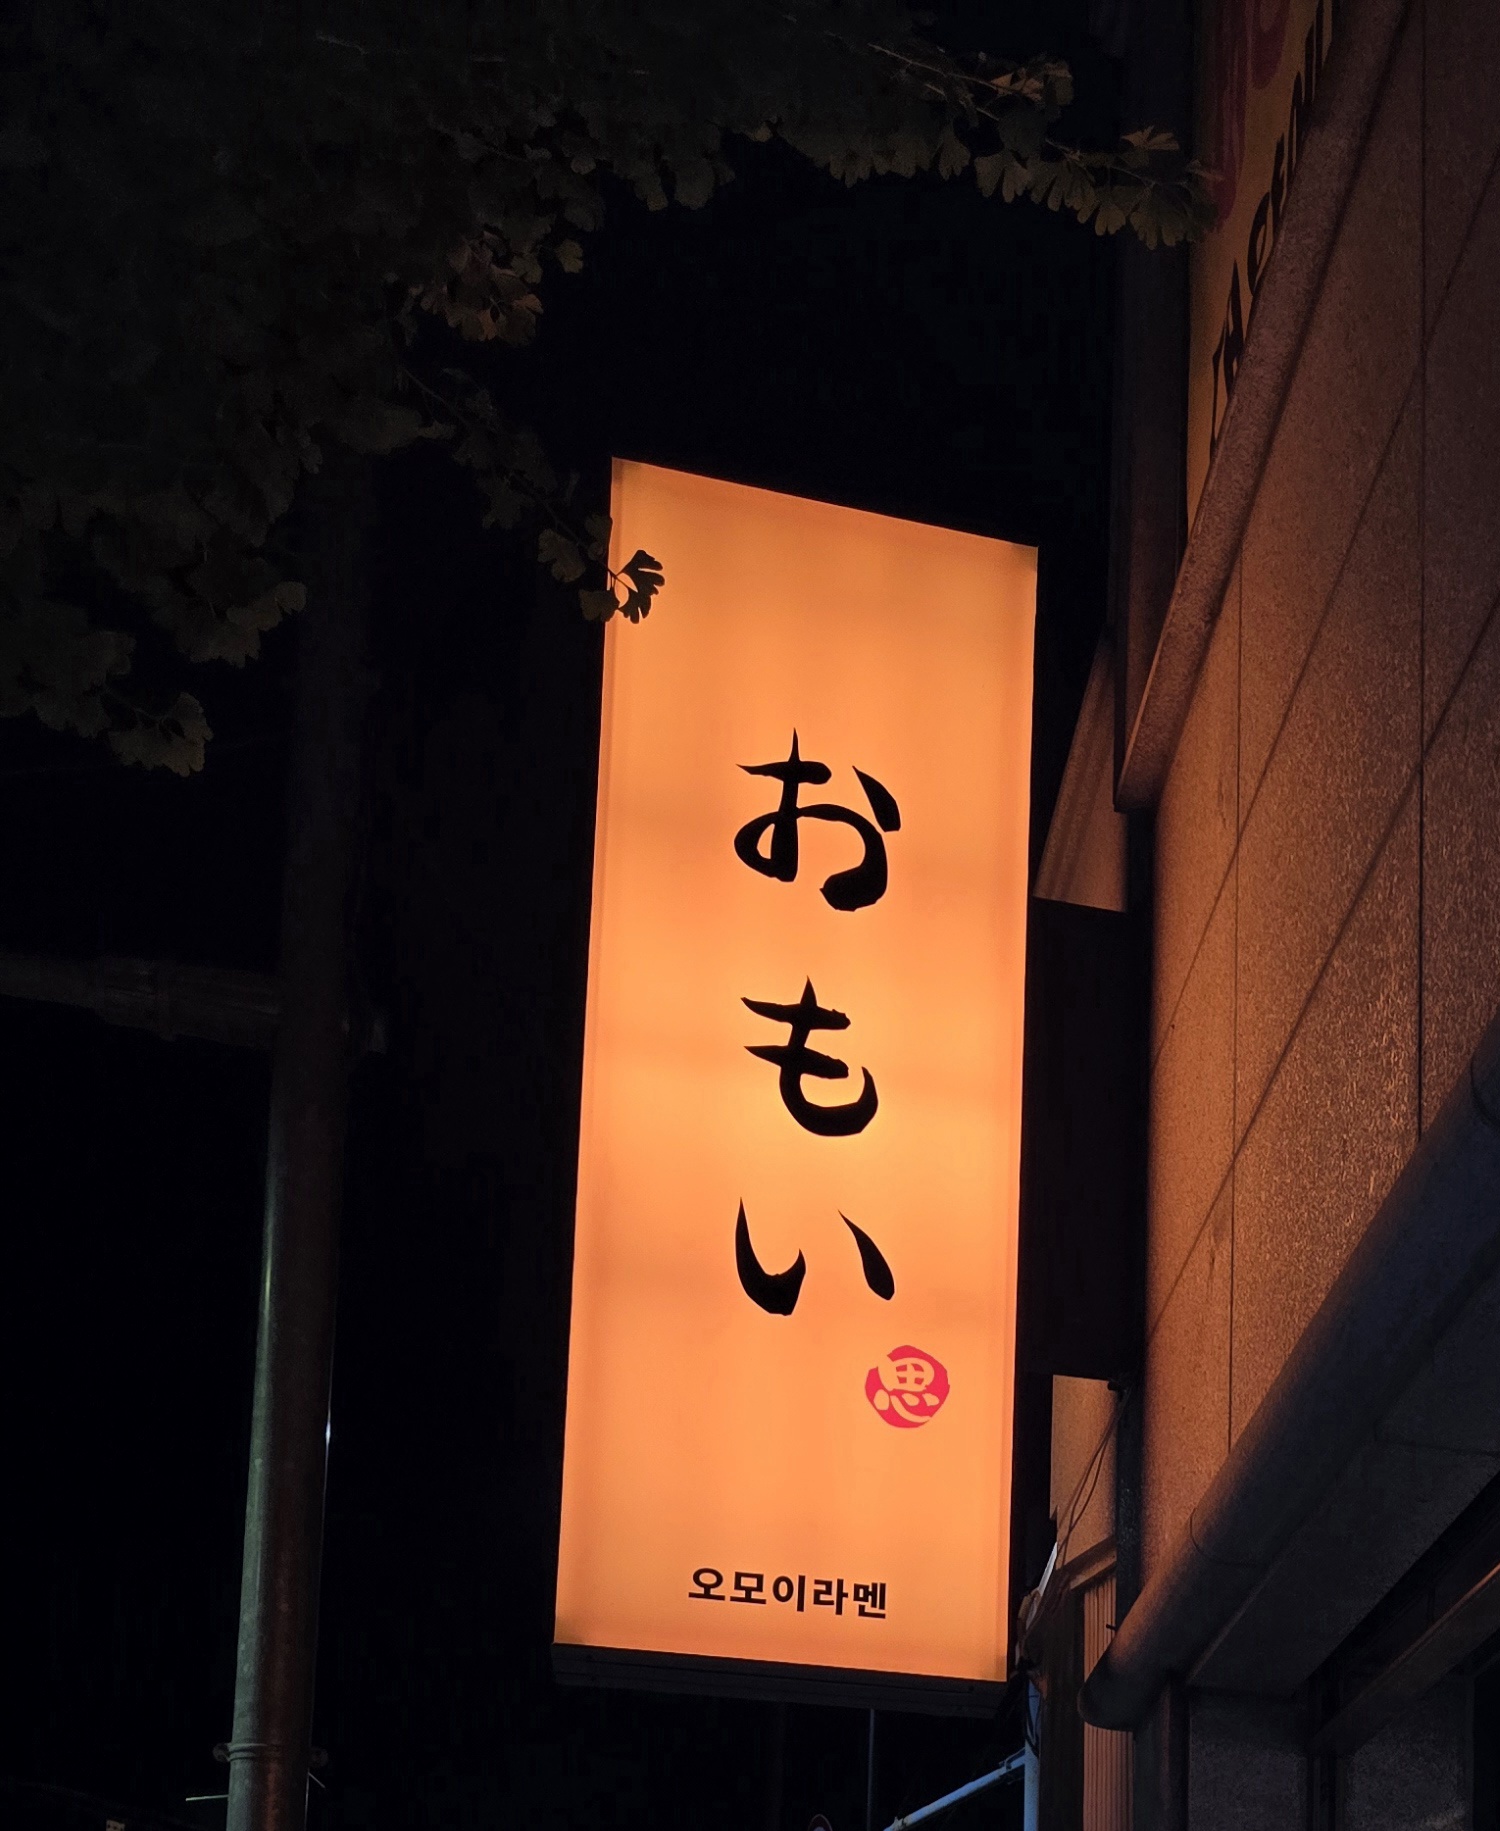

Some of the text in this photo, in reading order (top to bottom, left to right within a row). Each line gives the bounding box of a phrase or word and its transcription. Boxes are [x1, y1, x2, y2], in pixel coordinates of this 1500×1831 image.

[734, 728, 901, 1316] おもい
[688, 1567, 888, 1619] 오모이라멘
